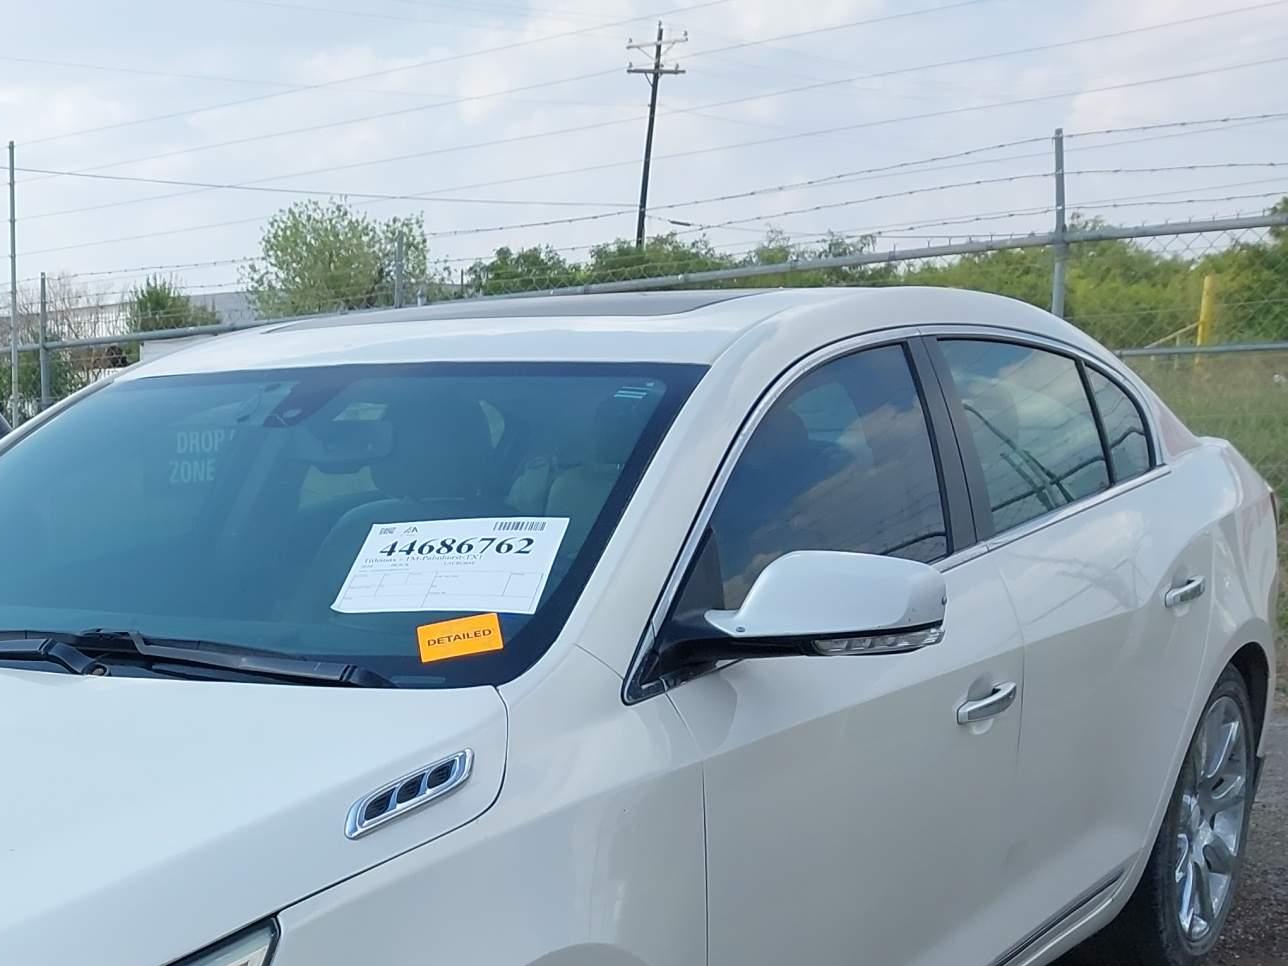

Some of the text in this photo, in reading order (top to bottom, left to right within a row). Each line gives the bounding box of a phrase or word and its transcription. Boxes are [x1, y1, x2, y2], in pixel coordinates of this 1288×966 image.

[176, 430, 225, 454] DROP
[169, 459, 216, 483] ZONE
[379, 536, 535, 557] 44686762
[427, 628, 492, 647] DETAILED
